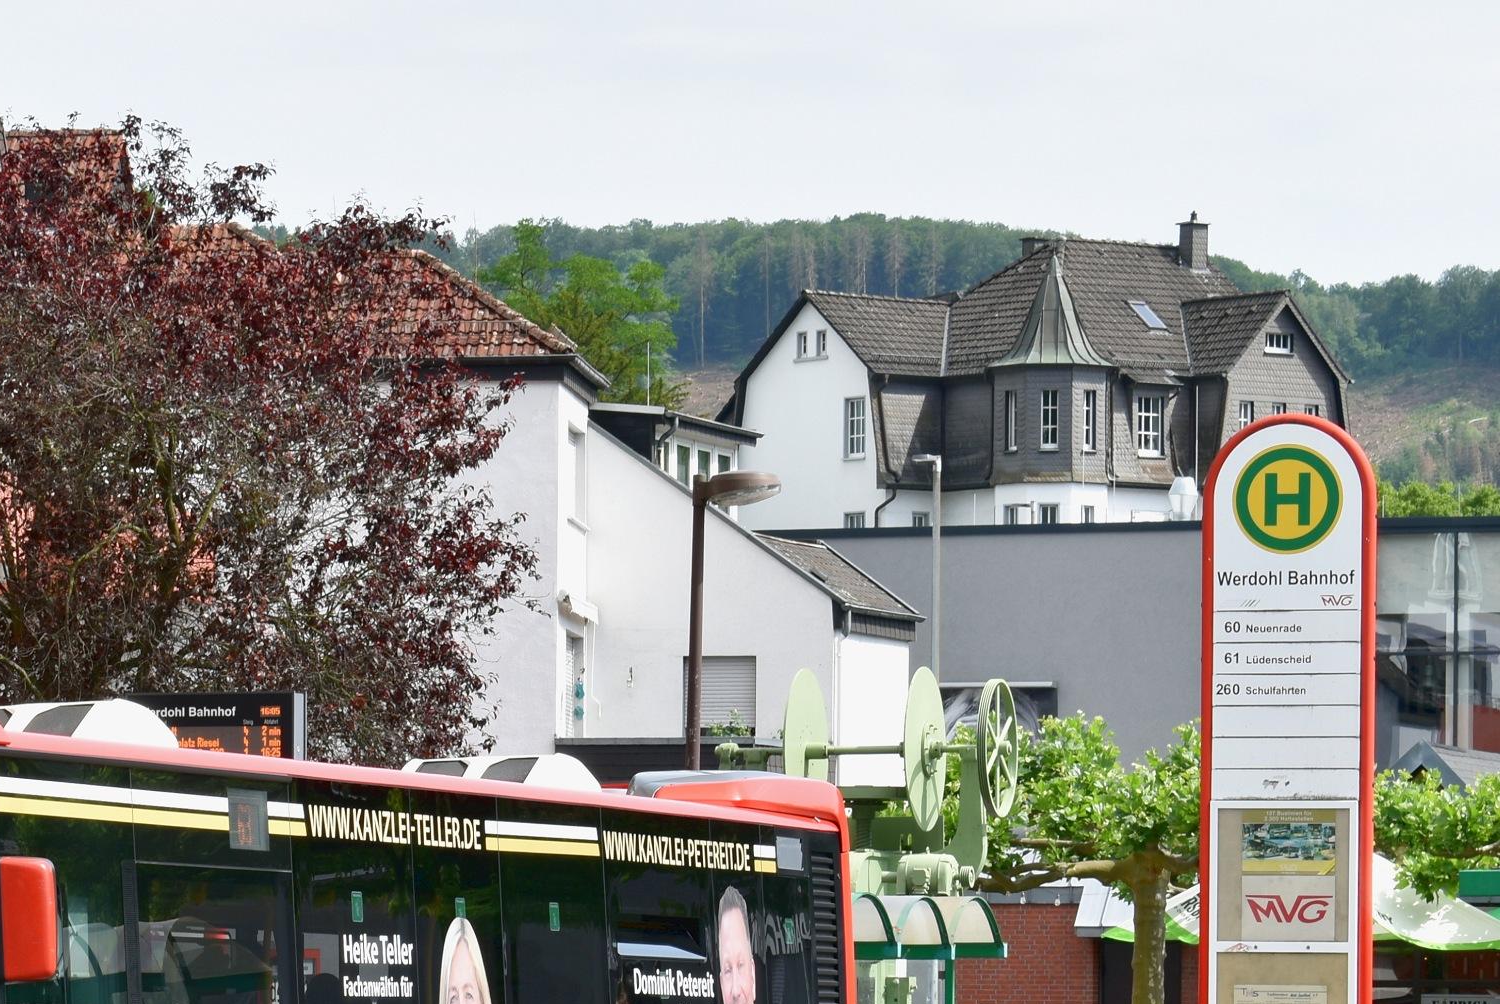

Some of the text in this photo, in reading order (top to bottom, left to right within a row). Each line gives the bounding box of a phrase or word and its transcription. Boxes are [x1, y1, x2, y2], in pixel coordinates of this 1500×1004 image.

[1217, 569, 1355, 586] Werdohl Bahnhof
[1319, 594, 1354, 607] MVG
[1224, 620, 1302, 633] 60 Neuenrade
[1224, 651, 1311, 665] 61 Lüdenscheid
[1216, 682, 1306, 696] 260 Schulfahrten
[188, 706, 237, 717] Bahnhof
[260, 706, 280, 716] 16:05
[262, 725, 267, 736] 2
[269, 727, 281, 736] min
[262, 737, 267, 747] 1
[269, 737, 281, 747] min
[308, 803, 482, 851] WWW.KANZLEI-TELLER.DE
[603, 830, 751, 873] WWW.KANZLEI-PETEREIT.DE
[1246, 894, 1333, 924] MVG
[343, 933, 413, 966] Heike Teller
[343, 975, 413, 998] Fachanwältin für
[633, 967, 715, 998] Dominik Petereit
